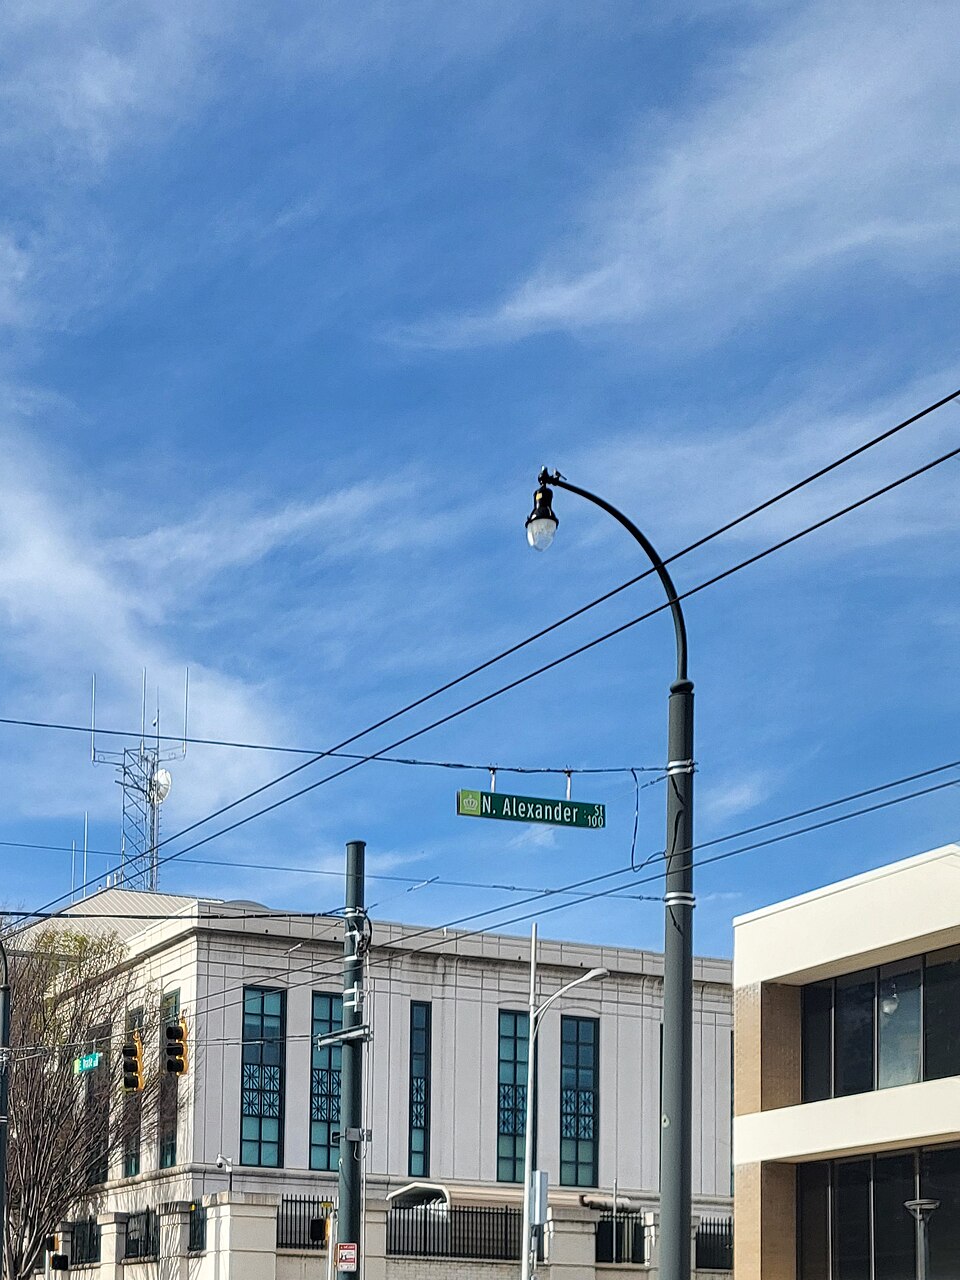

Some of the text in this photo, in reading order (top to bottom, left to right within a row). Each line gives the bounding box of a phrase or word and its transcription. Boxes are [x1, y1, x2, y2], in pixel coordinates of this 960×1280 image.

[482, 795, 578, 823] N. Alexander
[594, 804, 603, 816] St
[587, 815, 603, 827] 100
